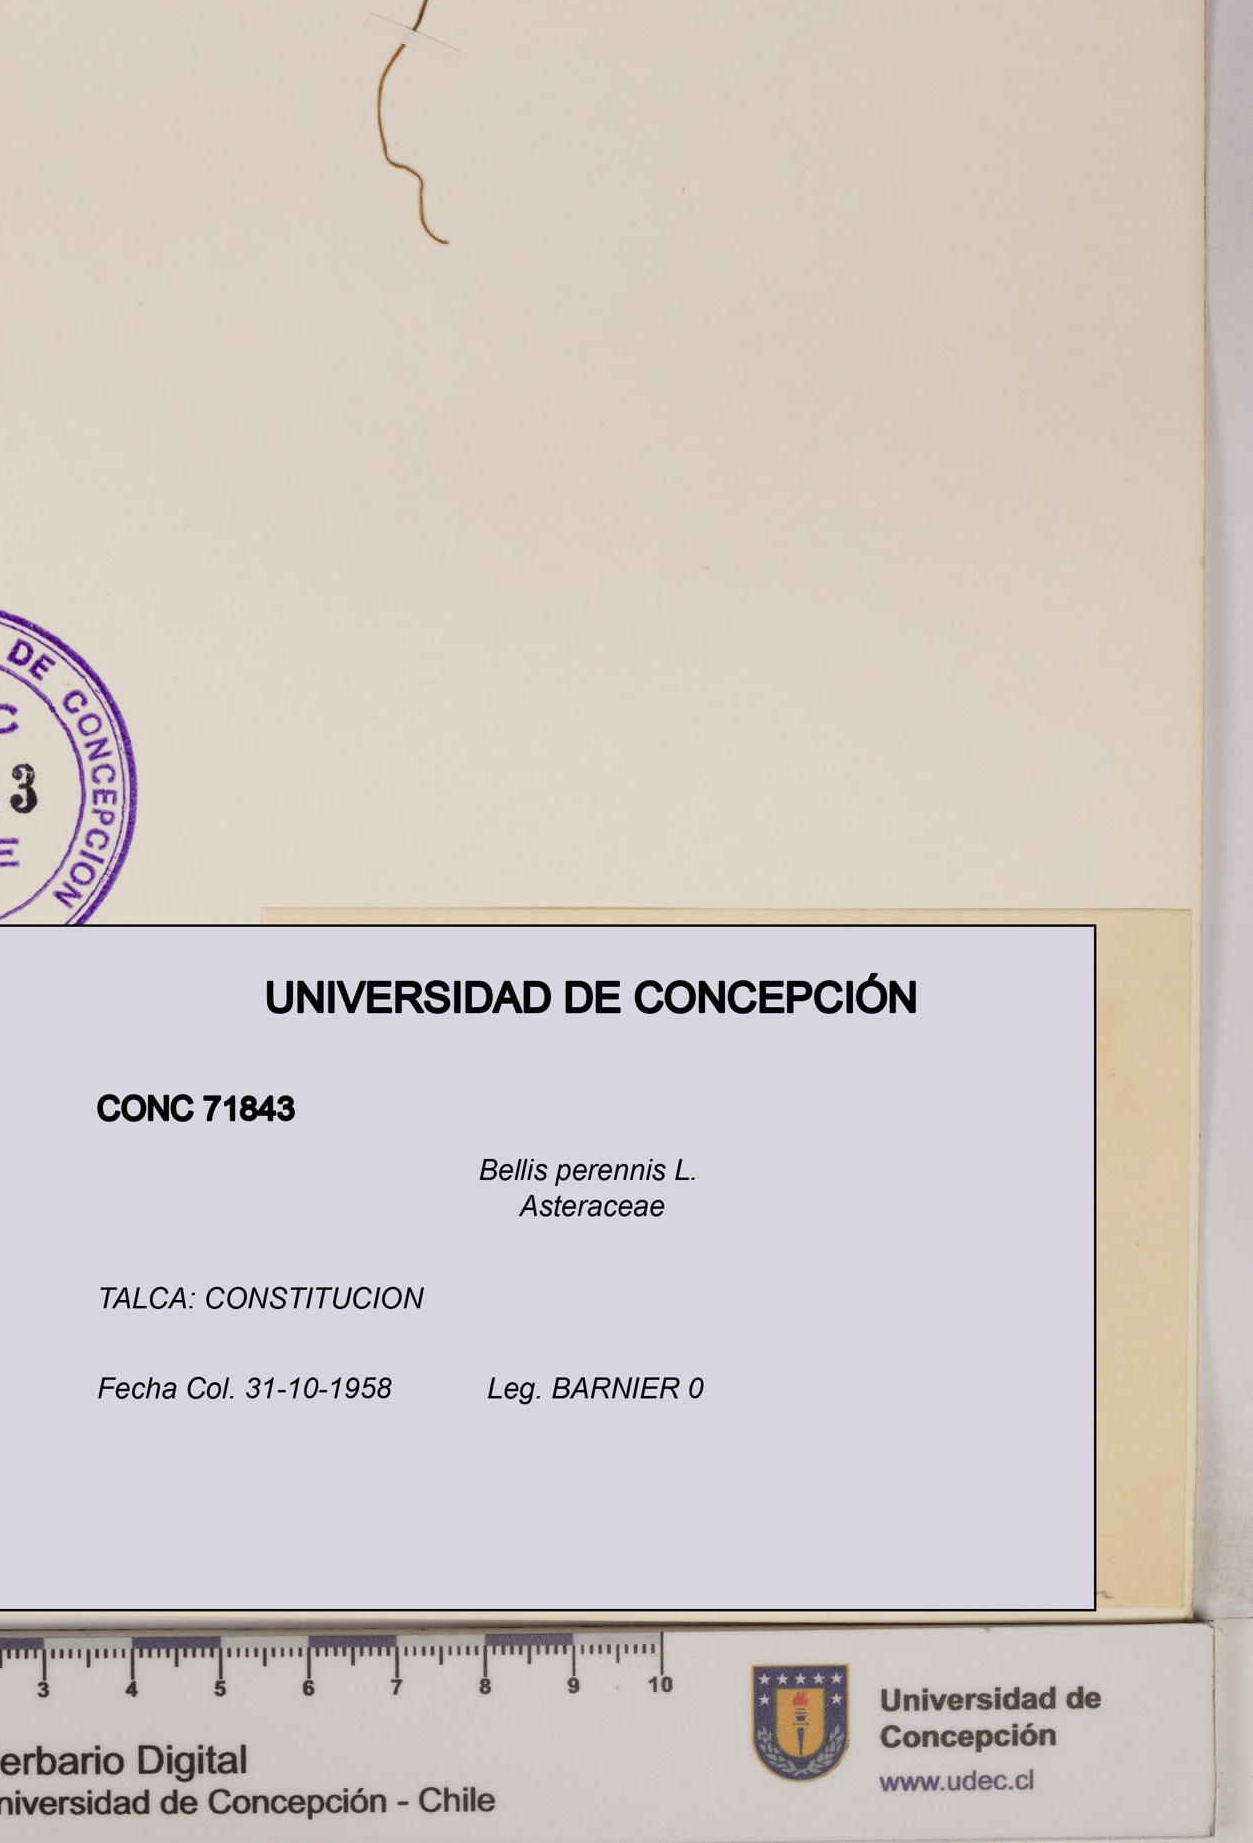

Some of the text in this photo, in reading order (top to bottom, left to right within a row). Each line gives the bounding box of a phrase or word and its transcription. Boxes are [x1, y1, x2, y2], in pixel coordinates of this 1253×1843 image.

[6, 638, 57, 682] DE
[53, 688, 118, 909] CONCEPCION
[37, 1681, 50, 1698] 3
[125, 1680, 139, 1698] 4
[214, 1680, 227, 1698] 5
[301, 1679, 315, 1697] 6
[390, 1678, 404, 1696] 7
[479, 1677, 492, 1695] 8
[567, 1676, 580, 1695] 9
[648, 1676, 673, 1693] 10
[881, 1685, 1102, 1712] Universidad de
[879, 1722, 1057, 1753] Concepción
[138, 1744, 247, 1783] Digital
[879, 1769, 1035, 1793] www.udec.cl
[160, 1789, 198, 1816] de
[208, 1787, 387, 1820] Concepción
[418, 1786, 496, 1814] Chile
